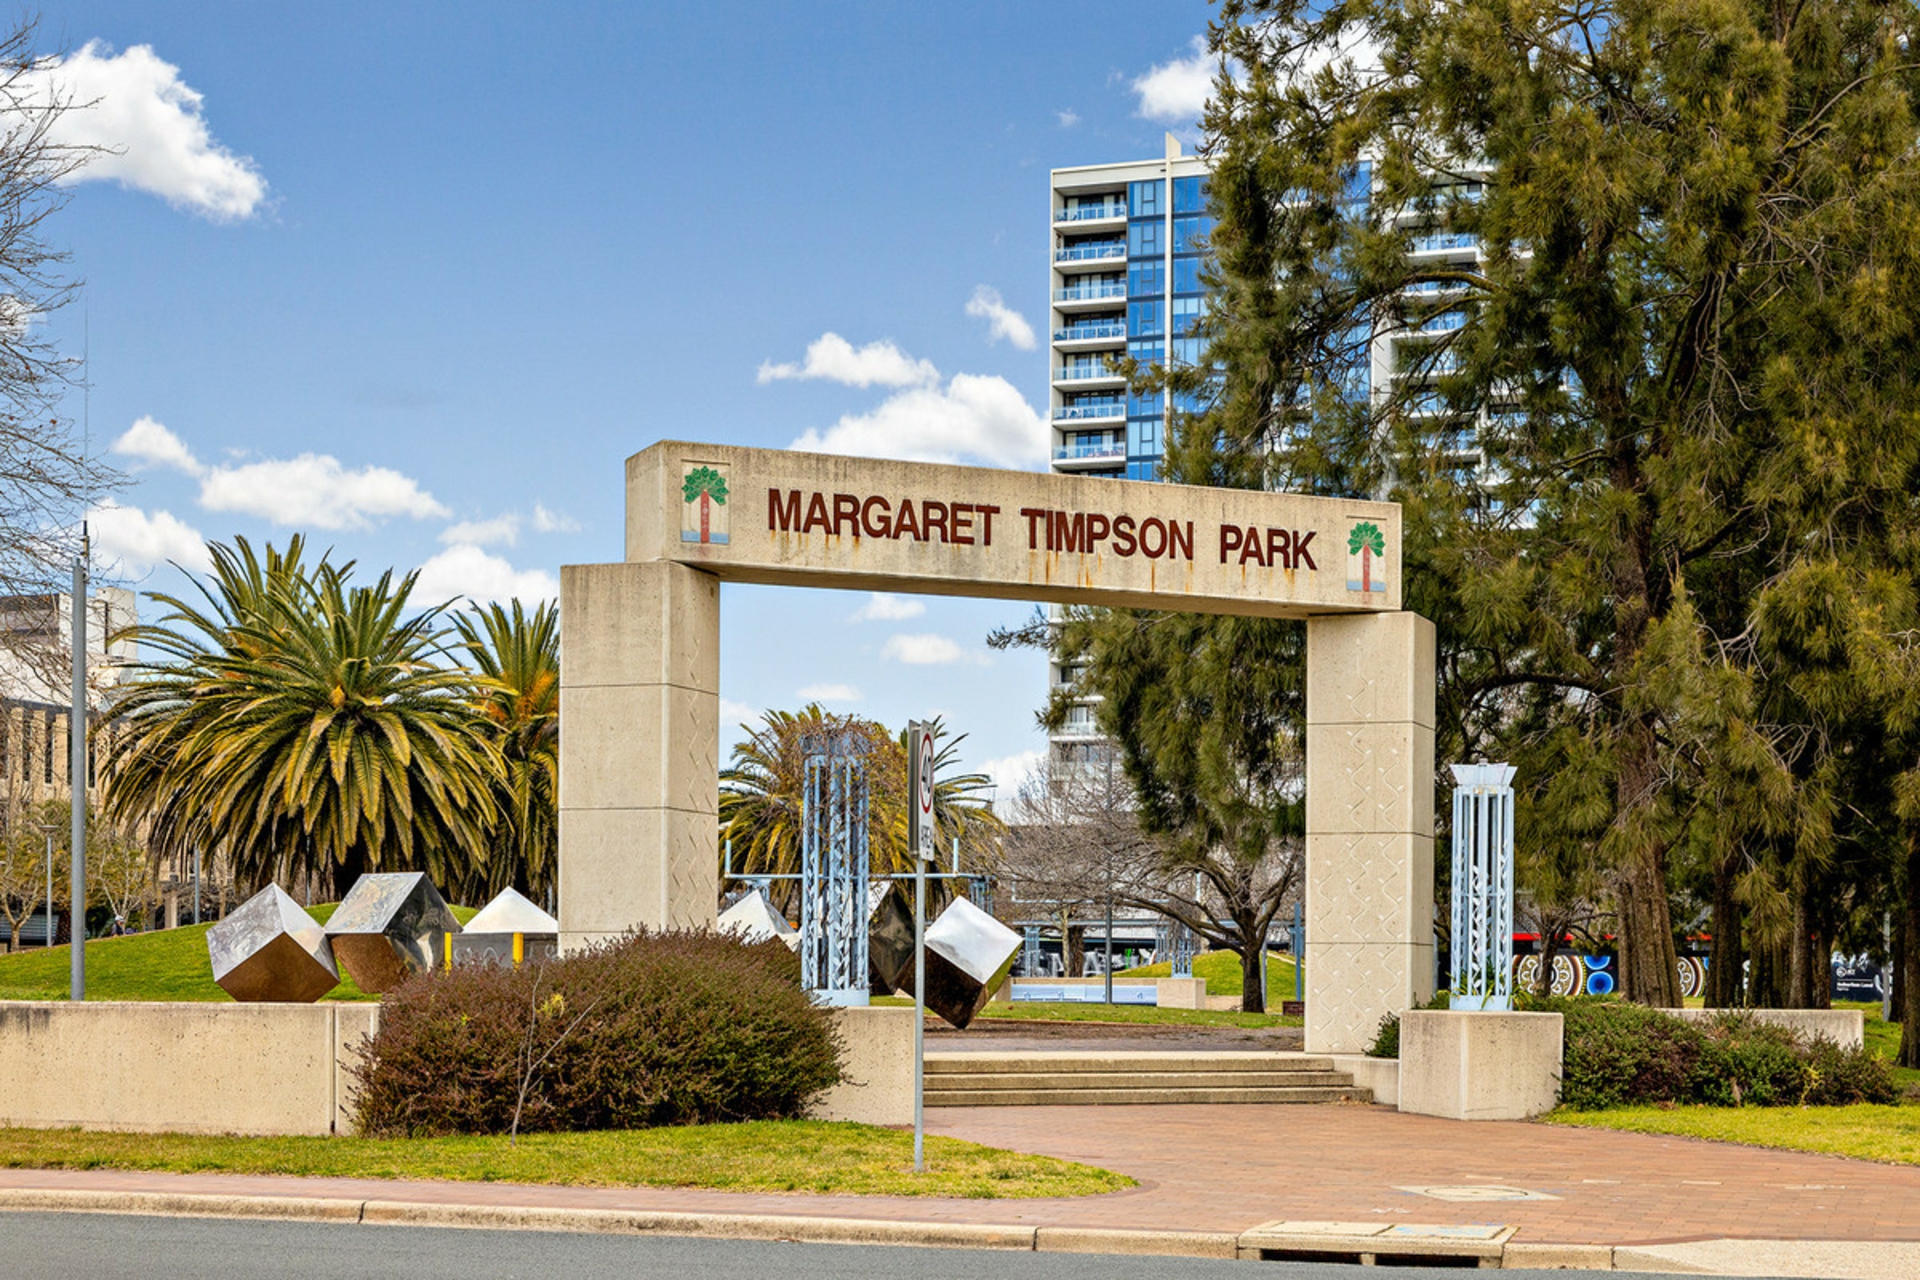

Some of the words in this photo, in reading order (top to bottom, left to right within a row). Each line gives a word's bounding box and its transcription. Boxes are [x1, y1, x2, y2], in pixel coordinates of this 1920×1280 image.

[768, 488, 1001, 546] MARGARET
[1020, 508, 1194, 561] TIMPSON
[1220, 524, 1317, 571] PARK
